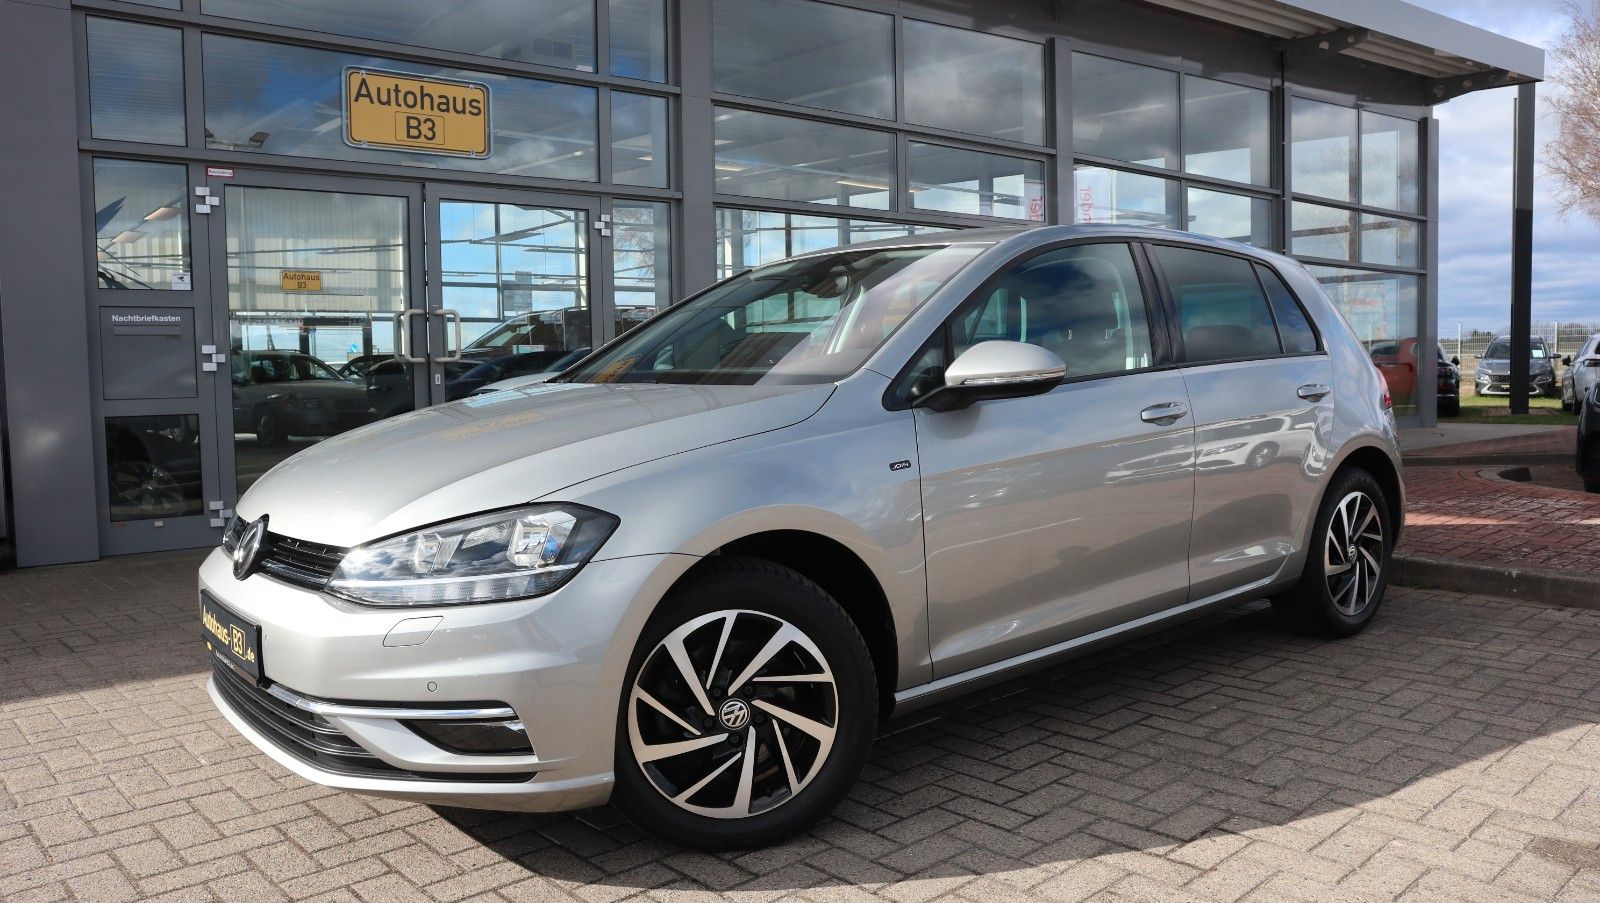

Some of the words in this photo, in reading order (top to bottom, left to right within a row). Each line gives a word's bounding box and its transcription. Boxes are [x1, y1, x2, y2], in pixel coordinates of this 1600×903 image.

[354, 78, 482, 116] Autohaus
[406, 115, 436, 141] B3
[283, 272, 320, 281] Autohaus
[297, 281, 307, 289] B3
[111, 314, 181, 322] Nachtbriefkasten
